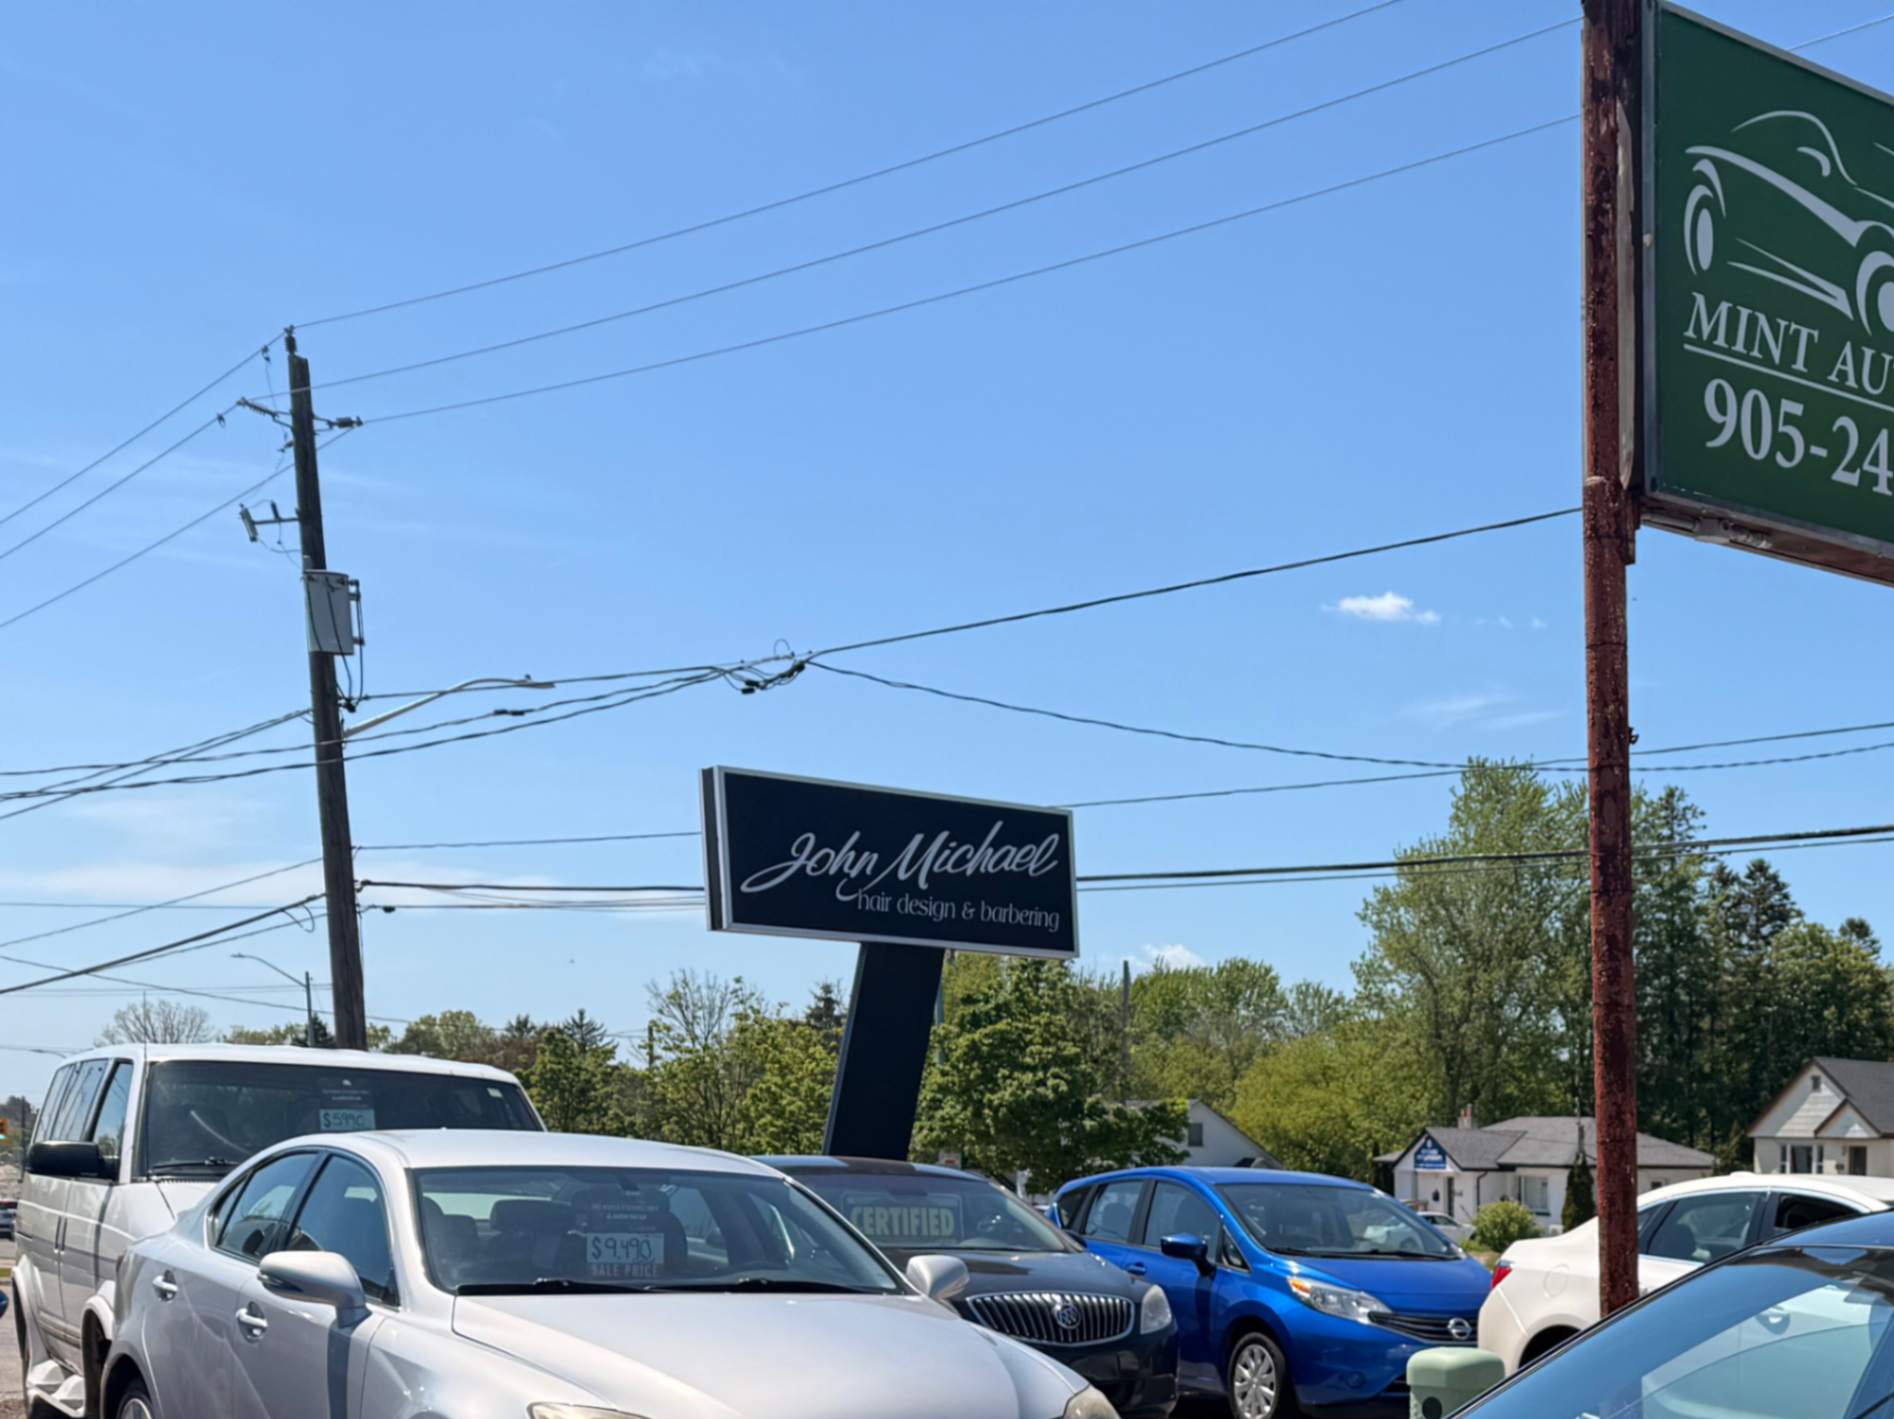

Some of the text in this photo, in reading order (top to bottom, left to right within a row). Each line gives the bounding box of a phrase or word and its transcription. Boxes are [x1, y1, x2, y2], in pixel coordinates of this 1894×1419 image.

[1683, 291, 1819, 373] MINT
[740, 820, 1060, 894] John Michael
[857, 889, 1060, 933] hair design & barbering
[850, 1206, 955, 1236] CERTIFIED
